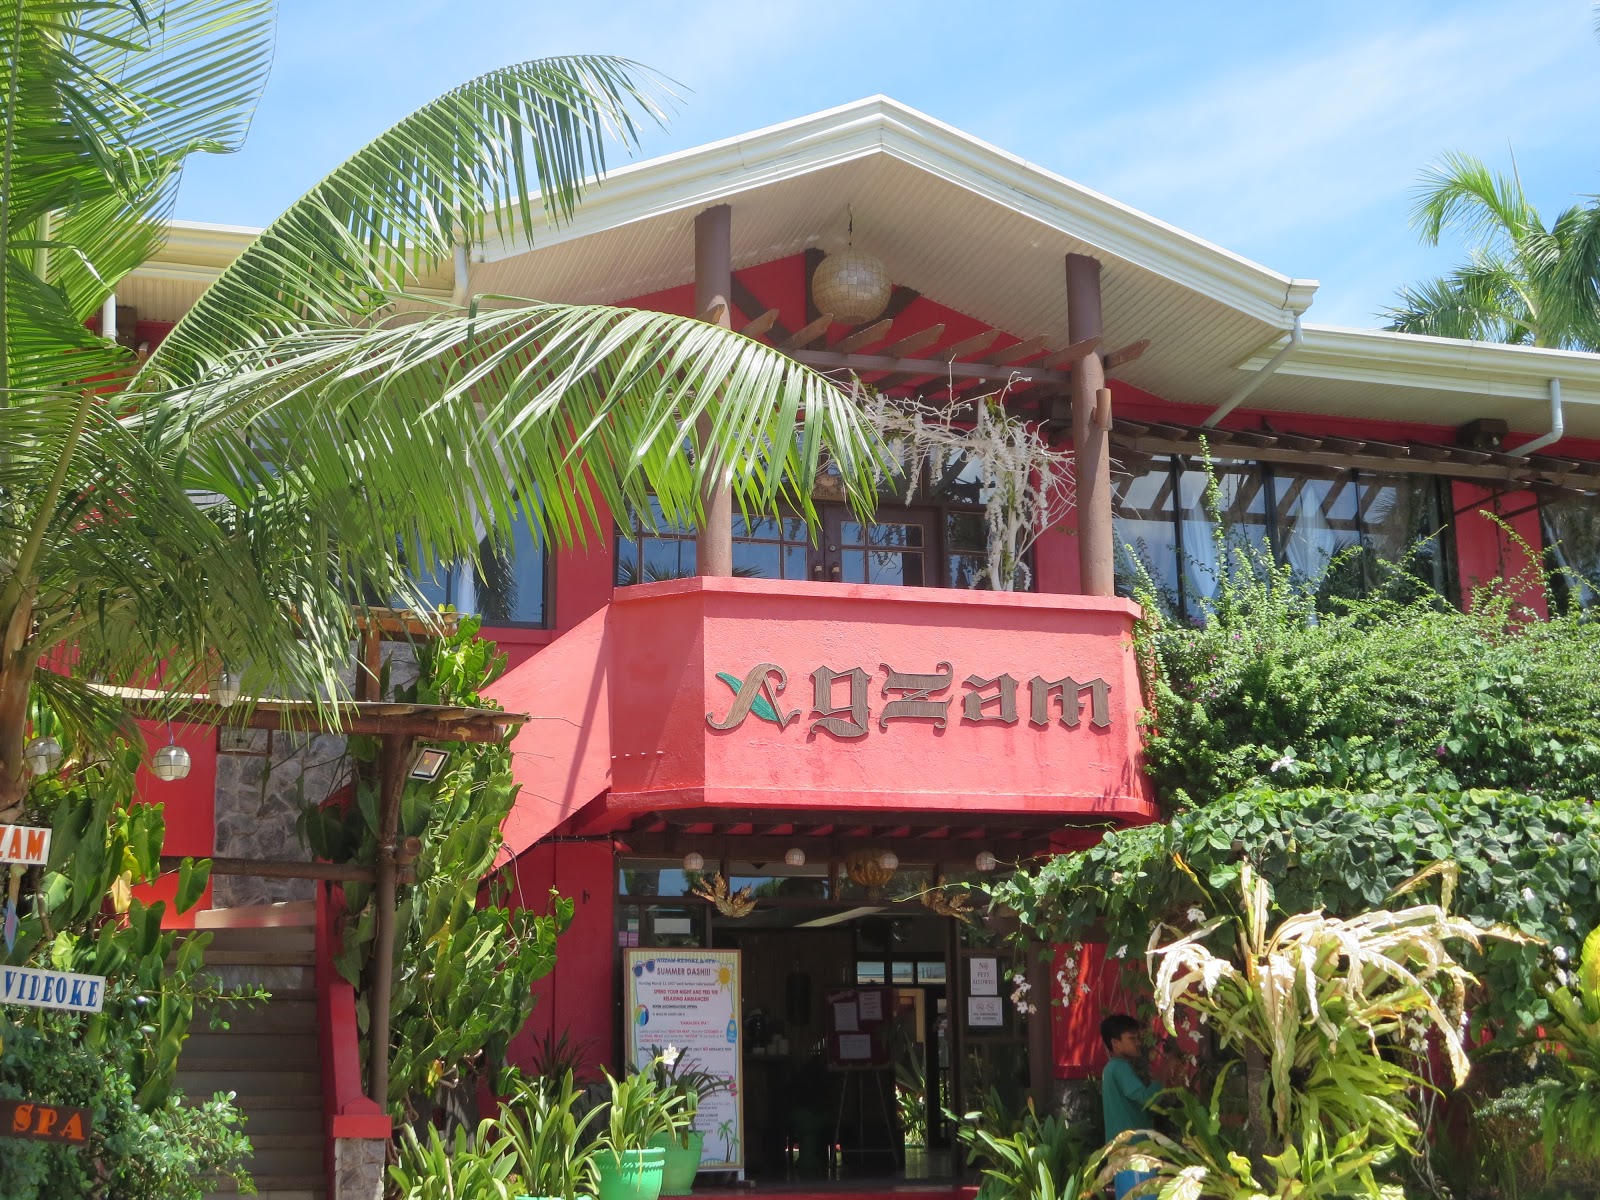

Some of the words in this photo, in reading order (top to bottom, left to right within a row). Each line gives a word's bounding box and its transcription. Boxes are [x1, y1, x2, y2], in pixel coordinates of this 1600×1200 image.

[705, 660, 1112, 737] Agzam
[5, 970, 99, 1008] VIDEOKE
[657, 967, 685, 976] SUMMER
[686, 968, 711, 976] DASH!!!
[13, 1103, 85, 1140] SPA
